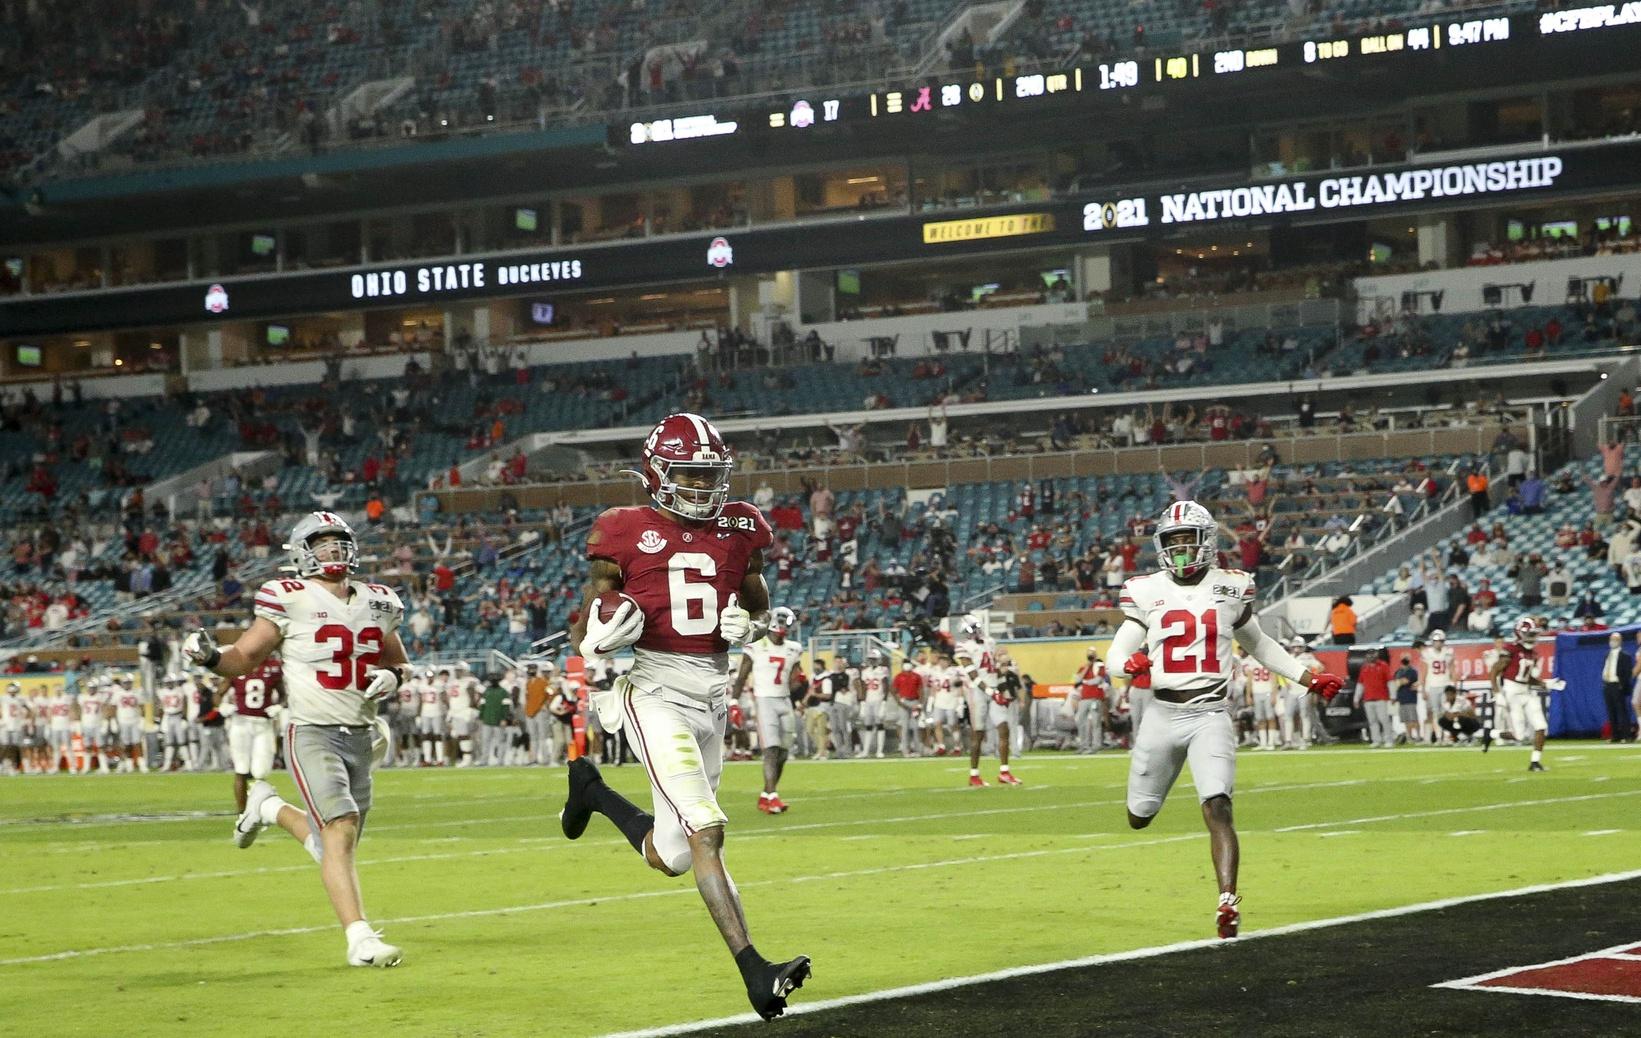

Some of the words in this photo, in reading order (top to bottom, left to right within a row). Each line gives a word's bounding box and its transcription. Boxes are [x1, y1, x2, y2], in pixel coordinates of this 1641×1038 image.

[1407, 27, 1430, 50] 44
[1482, 17, 1509, 42] PM
[1098, 61, 1138, 89] 1:49
[822, 100, 840, 121] 17
[1083, 198, 1149, 231] 2021
[1160, 182, 1316, 223] NATIONAL
[1319, 156, 1562, 208] CHAMPIONSHIP
[929, 225, 991, 239] WELCOME
[1000, 220, 1015, 232] TO
[351, 270, 407, 298] OHIO
[417, 263, 485, 293] STATE
[498, 260, 582, 285] BUCKEYES
[717, 516, 757, 532] 2021
[667, 552, 718, 636] 6
[1161, 608, 1220, 673] 21
[314, 624, 385, 691] 32
[769, 656, 785, 685] 7
[244, 678, 265, 709] 8
